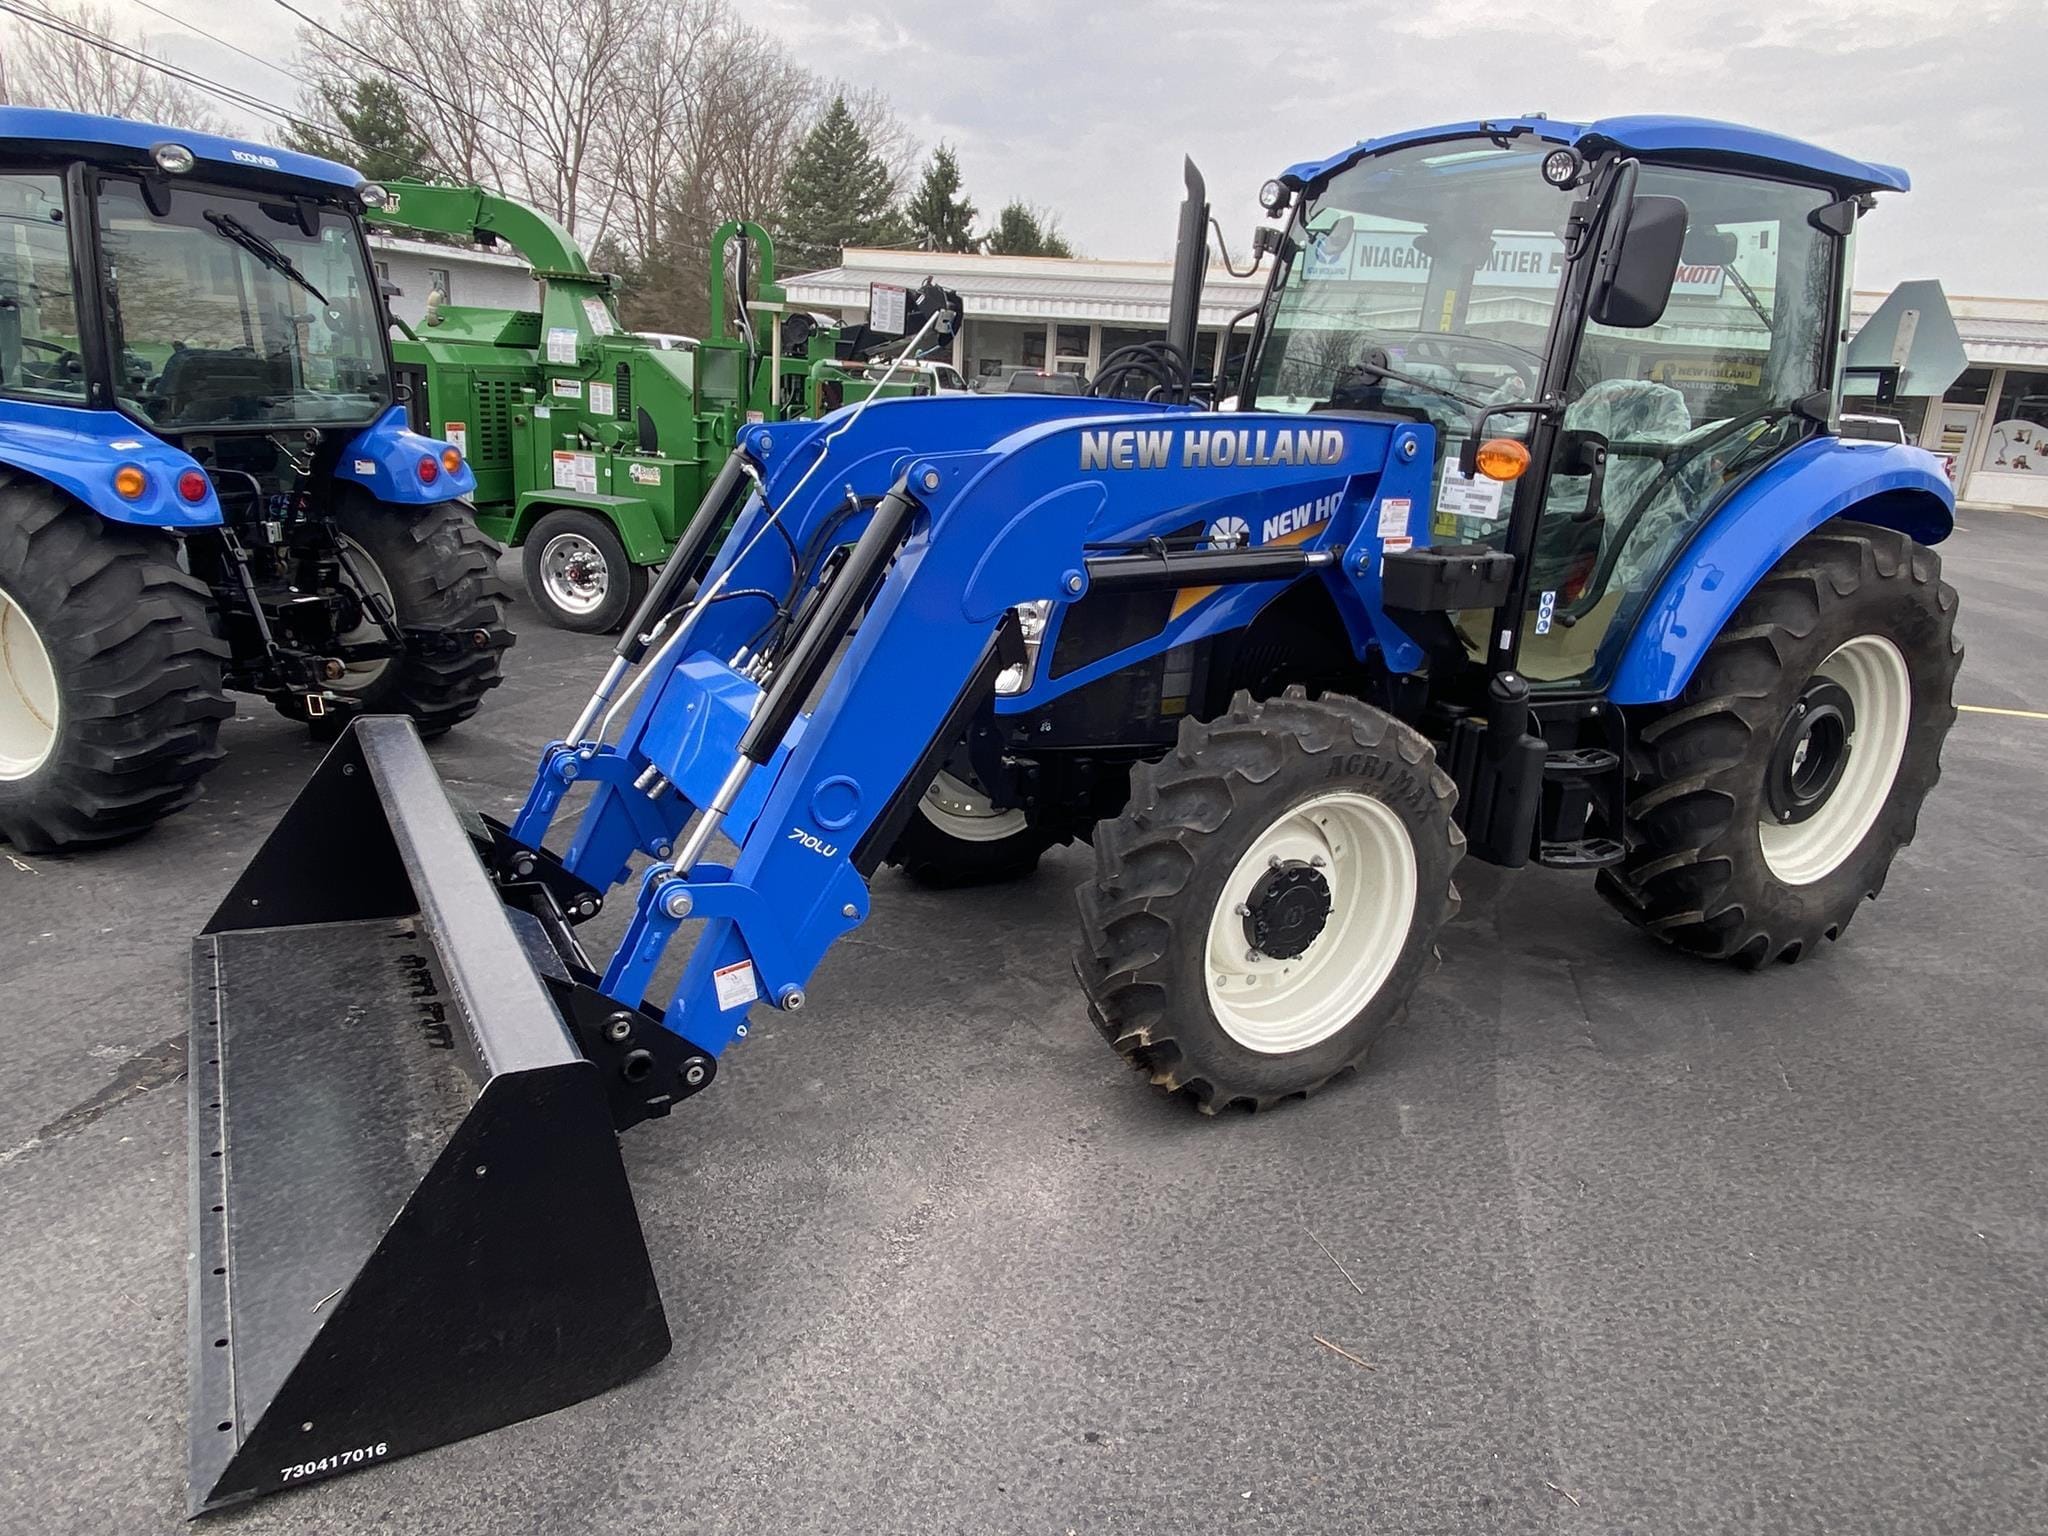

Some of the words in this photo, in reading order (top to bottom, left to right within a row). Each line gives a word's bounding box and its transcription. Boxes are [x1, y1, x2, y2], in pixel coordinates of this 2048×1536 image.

[231, 150, 279, 168] BOOMER
[1360, 245, 1430, 269] NIAGAR
[1080, 431, 1173, 471] NEW
[1182, 429, 1344, 468] HOLLAND
[1262, 502, 1312, 543] NEW
[1315, 491, 1345, 522] HO
[788, 828, 838, 857] 710LU
[280, 1442, 388, 1482] 730417016
